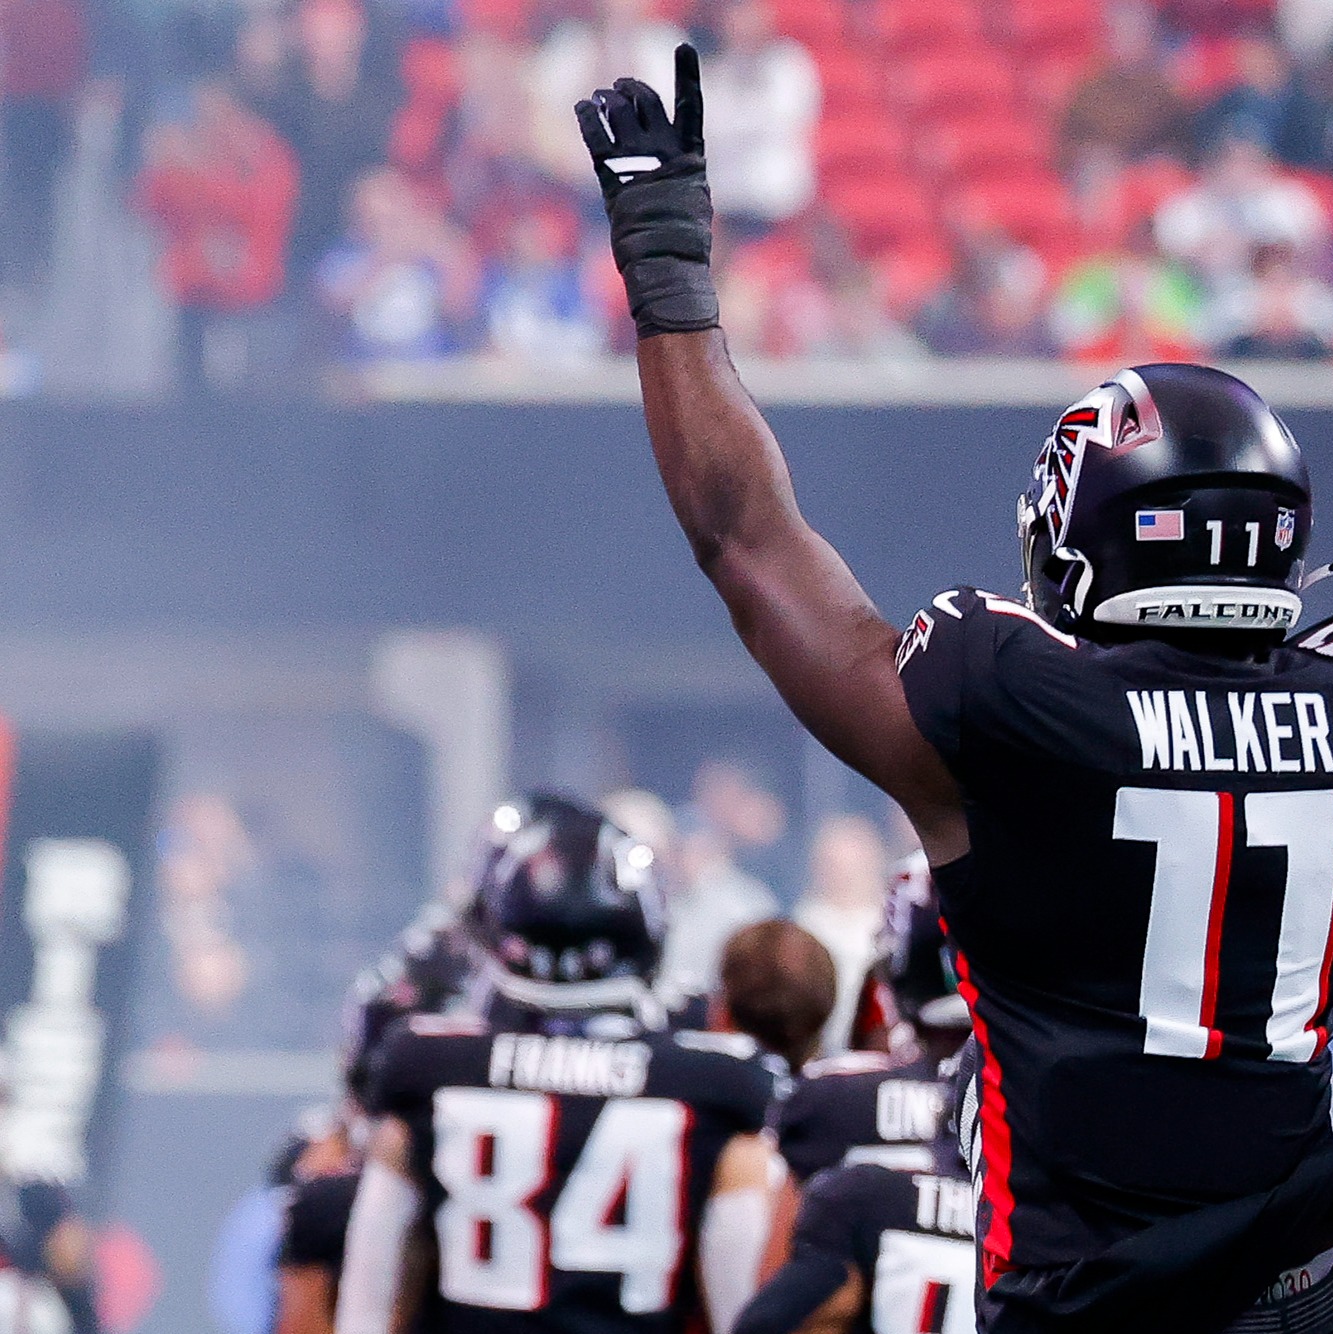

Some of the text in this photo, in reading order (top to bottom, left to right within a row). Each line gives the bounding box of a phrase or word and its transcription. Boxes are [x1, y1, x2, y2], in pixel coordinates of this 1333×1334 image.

[1206, 520, 1260, 567] 11
[1137, 603, 1295, 623] FALCONS
[431, 1085, 697, 1315] 84
